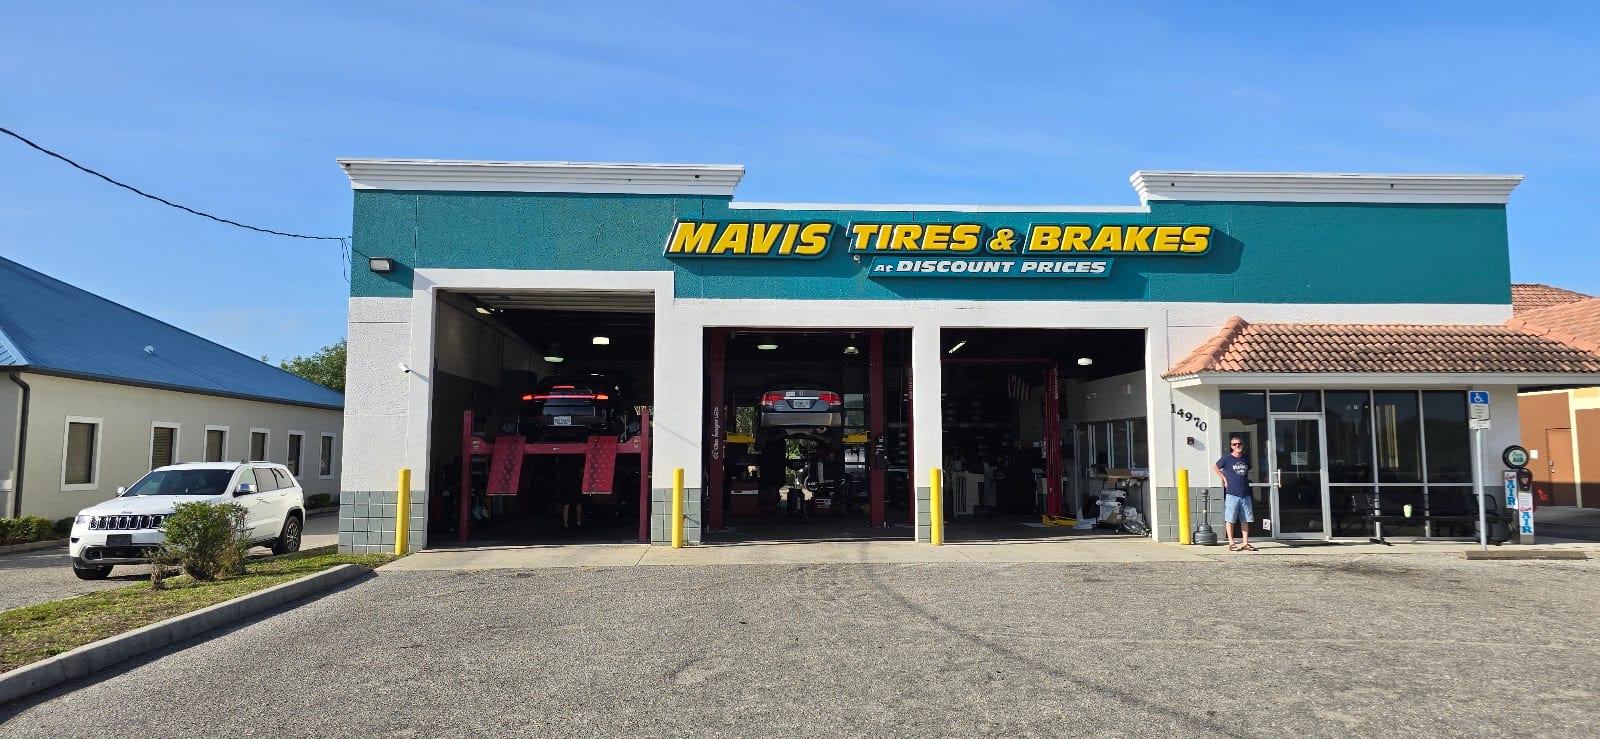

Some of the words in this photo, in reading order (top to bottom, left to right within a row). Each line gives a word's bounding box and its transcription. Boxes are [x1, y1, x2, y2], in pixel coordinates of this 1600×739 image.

[669, 222, 832, 255] MAVIS
[853, 224, 982, 251] TIRES
[989, 228, 1015, 251] &
[1029, 225, 1211, 253] BRAKES
[896, 260, 1016, 273] DISCOUNT
[1020, 261, 1108, 273] PRICES
[1171, 403, 1208, 432] 14970
[1507, 480, 1516, 506] AIR
[1521, 511, 1533, 534] AIR
